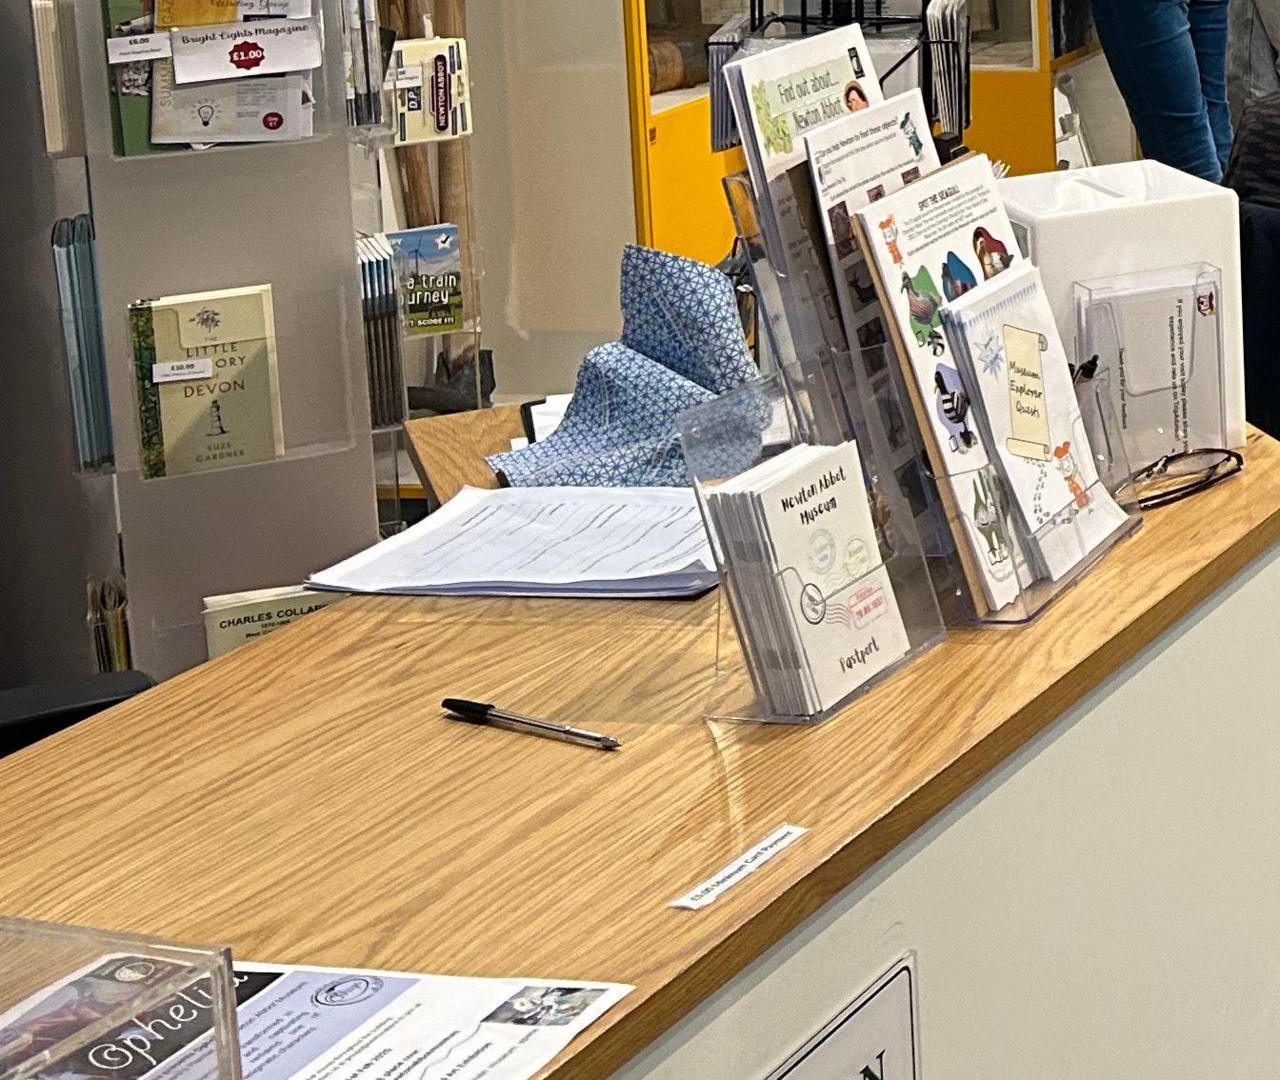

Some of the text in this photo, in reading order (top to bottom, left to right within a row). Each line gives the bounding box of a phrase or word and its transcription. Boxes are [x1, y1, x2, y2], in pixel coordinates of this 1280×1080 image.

[182, 23, 310, 45] Bright Lights Magazine
[232, 49, 263, 61] £1.00
[777, 80, 795, 104] Find
[796, 76, 809, 94] out
[792, 105, 822, 131] Newton
[407, 273, 457, 290] a train
[400, 289, 449, 305] ourney
[186, 341, 238, 358] LITTLE
[184, 379, 245, 398] DEVON
[781, 466, 847, 512] Newton Abbot
[800, 497, 837, 525] Museum
[219, 612, 272, 630] CHARLES
